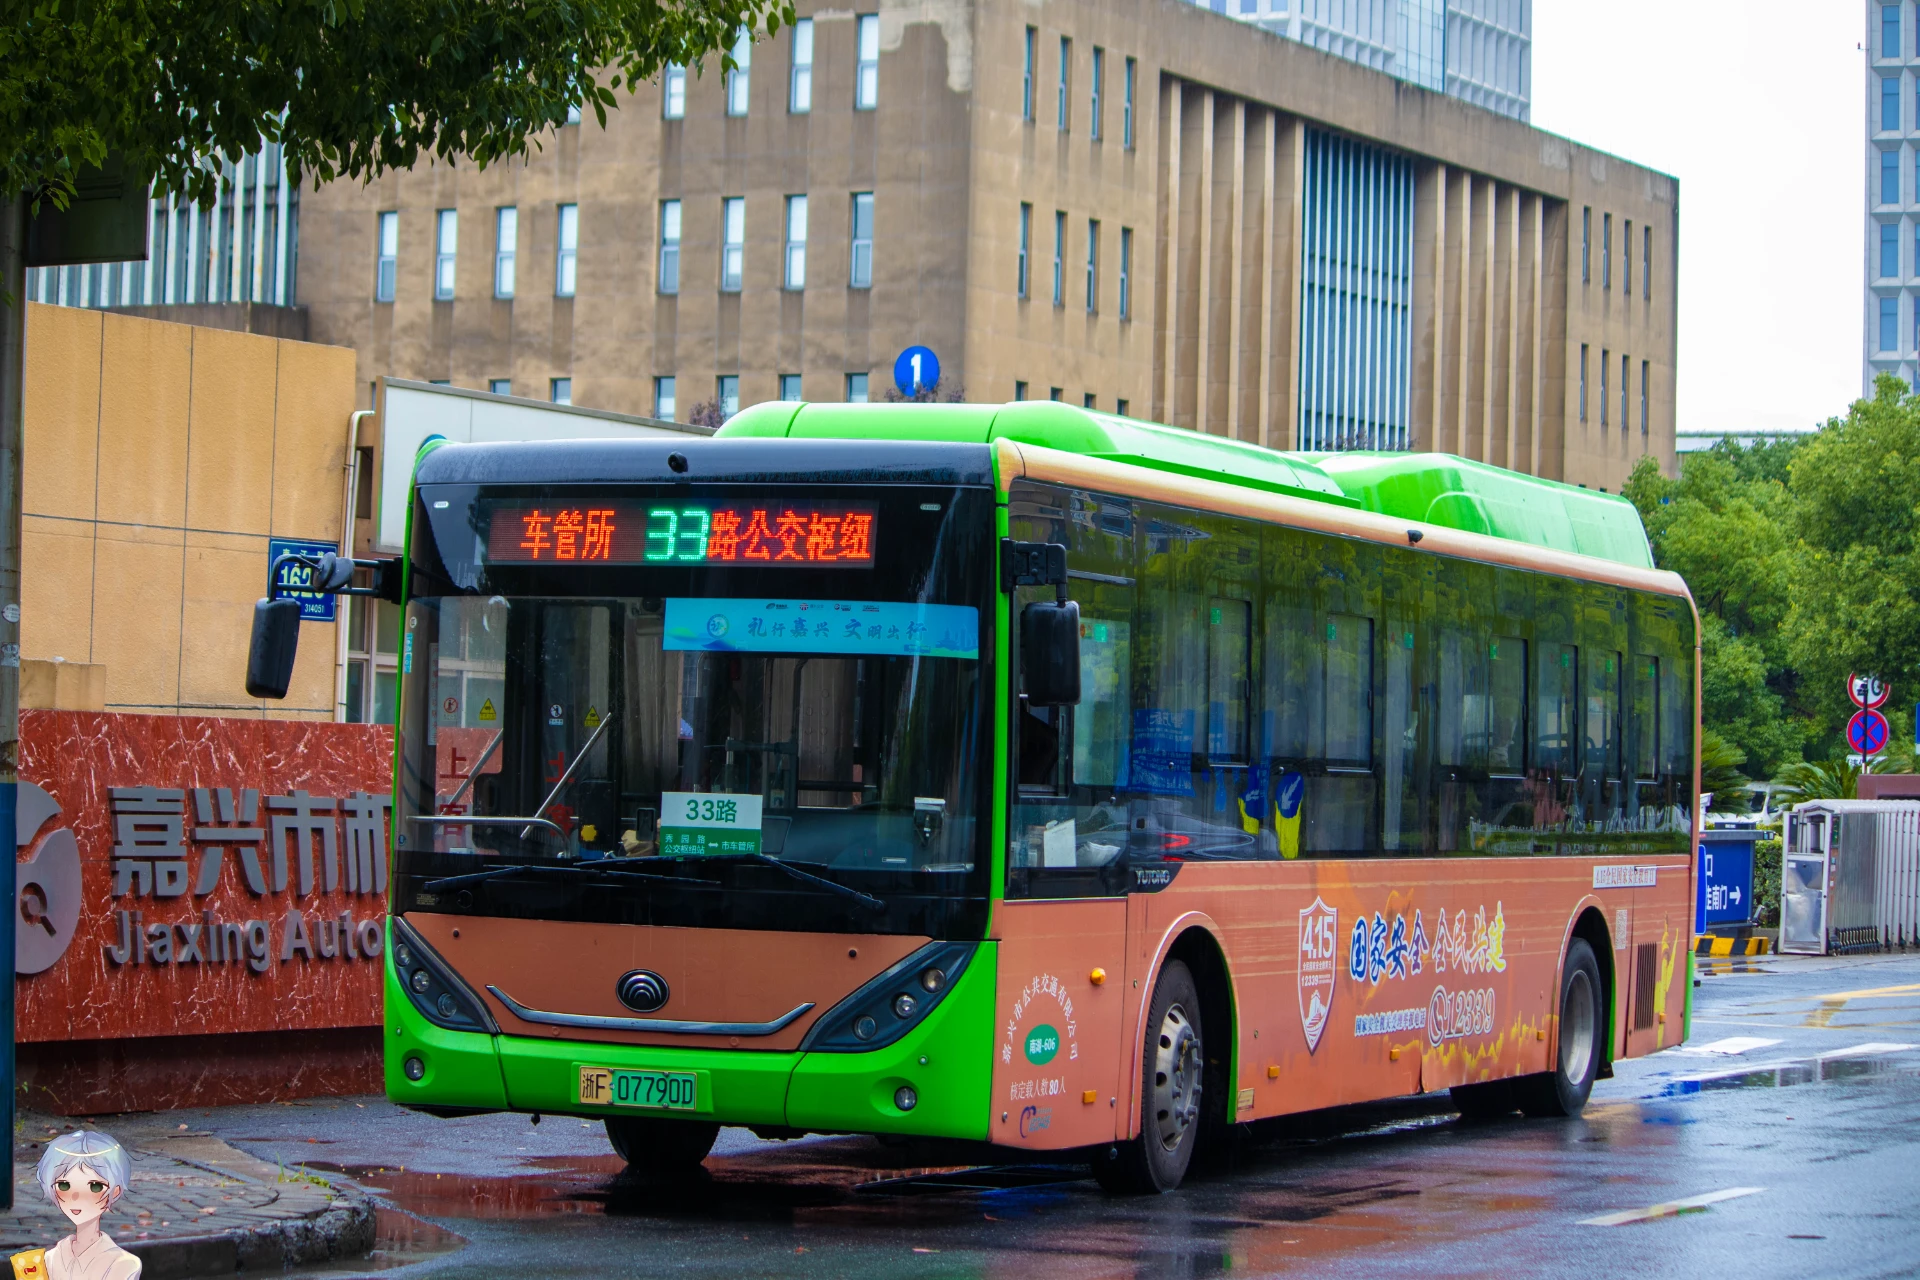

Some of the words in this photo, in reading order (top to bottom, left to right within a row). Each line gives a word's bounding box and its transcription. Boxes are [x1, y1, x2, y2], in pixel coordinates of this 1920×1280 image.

[910, 353, 921, 389] 1
[520, 509, 615, 560] 车管所
[645, 510, 709, 561] 33
[281, 564, 325, 599] 162
[304, 603, 325, 614] 314051
[747, 616, 830, 639] 礼行嘉兴
[843, 618, 928, 642] 文明出行
[685, 799, 737, 823] 33路
[664, 844, 706, 855] 公交枢纽站
[721, 841, 755, 852] 市车管所
[1135, 869, 1171, 885] YUTONG
[105, 910, 270, 972] Jiaxing
[280, 909, 383, 961] Auto
[1302, 915, 1334, 960] 4.15
[1350, 910, 1430, 986] 国家安全
[1431, 900, 1507, 975] 全民共建
[1301, 974, 1319, 987] 12339
[1445, 987, 1496, 1039] 12339
[1029, 1037, 1056, 1055] 南湖-606
[582, 1073, 607, 1099] 浙F
[617, 1074, 693, 1105] 07790D
[1010, 1076, 1066, 1101] 核定载人数80人
